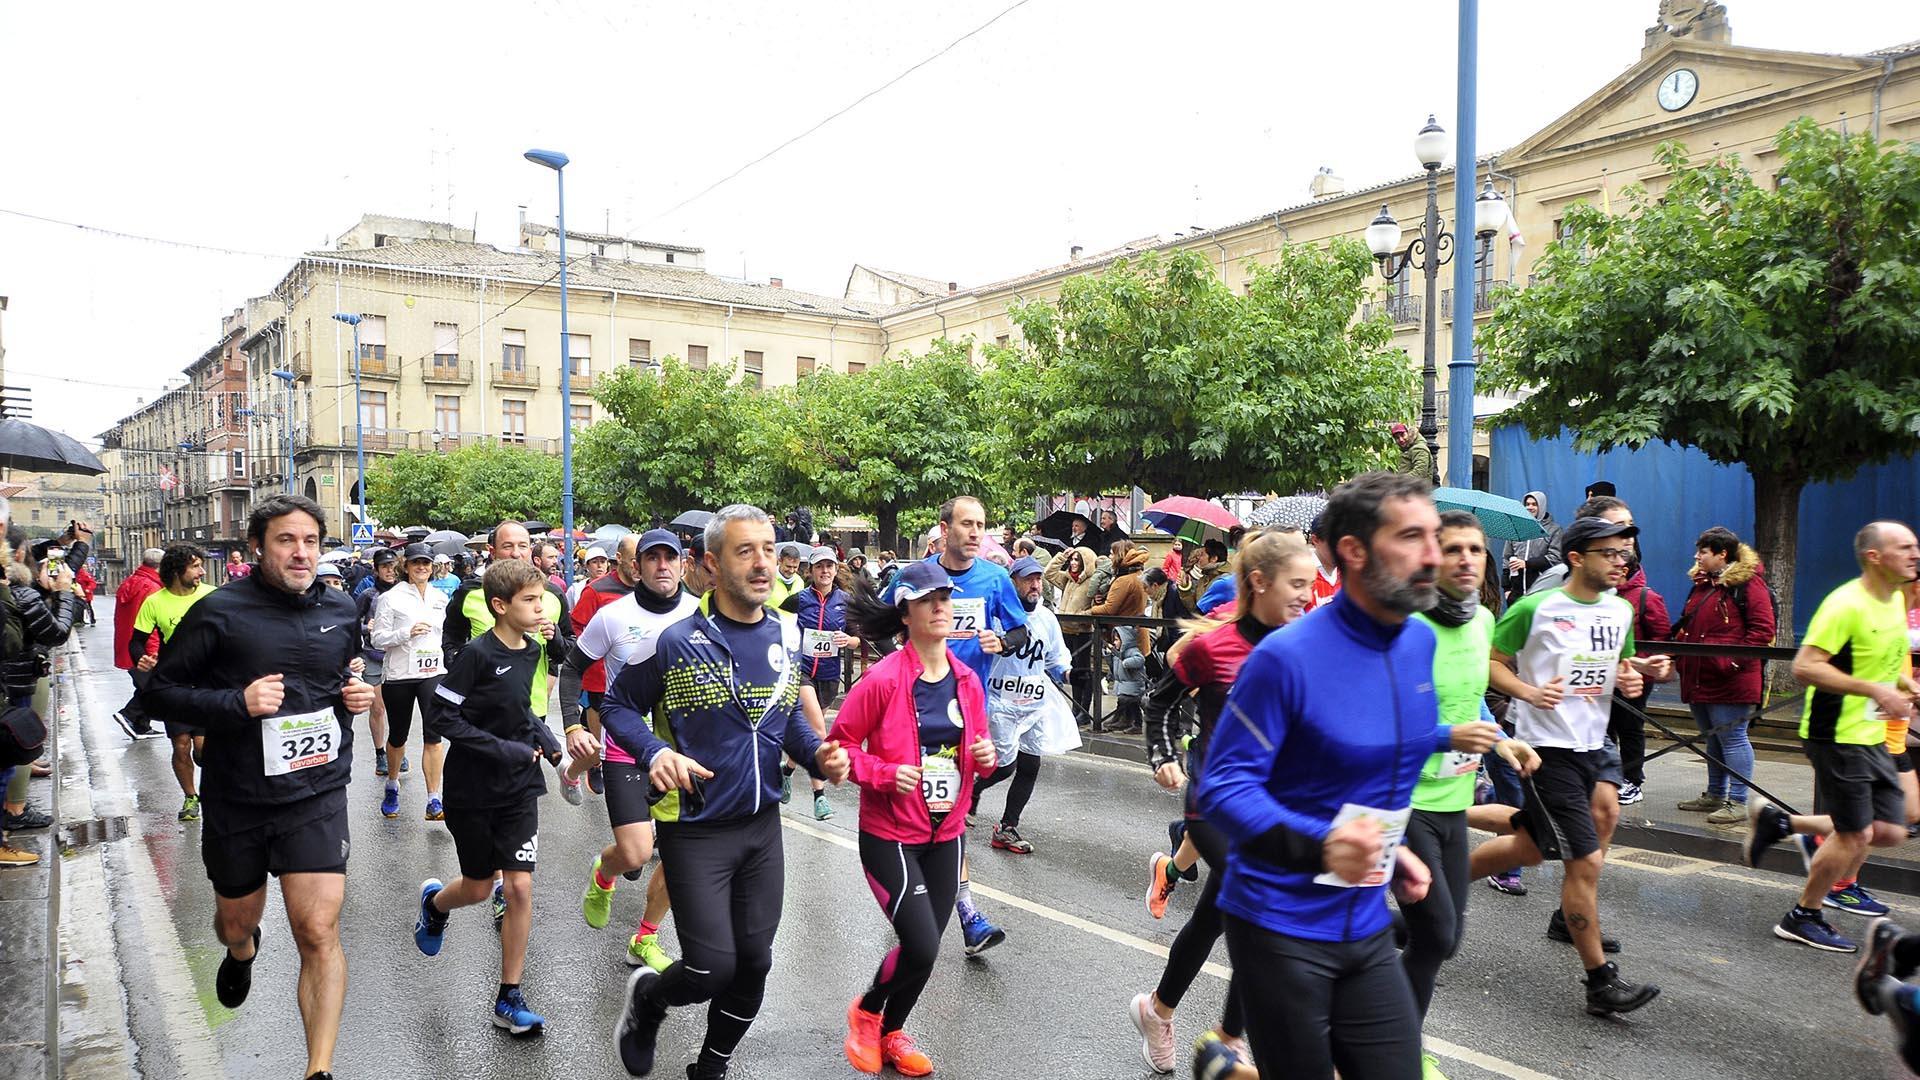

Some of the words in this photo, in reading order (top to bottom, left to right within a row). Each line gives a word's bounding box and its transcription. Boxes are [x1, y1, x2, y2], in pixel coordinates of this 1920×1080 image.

[953, 616, 977, 630] 72
[814, 641, 831, 652] 40
[416, 657, 439, 668] 101
[1569, 669, 1607, 686] 255
[281, 733, 332, 761] 323
[922, 780, 949, 799] 95
